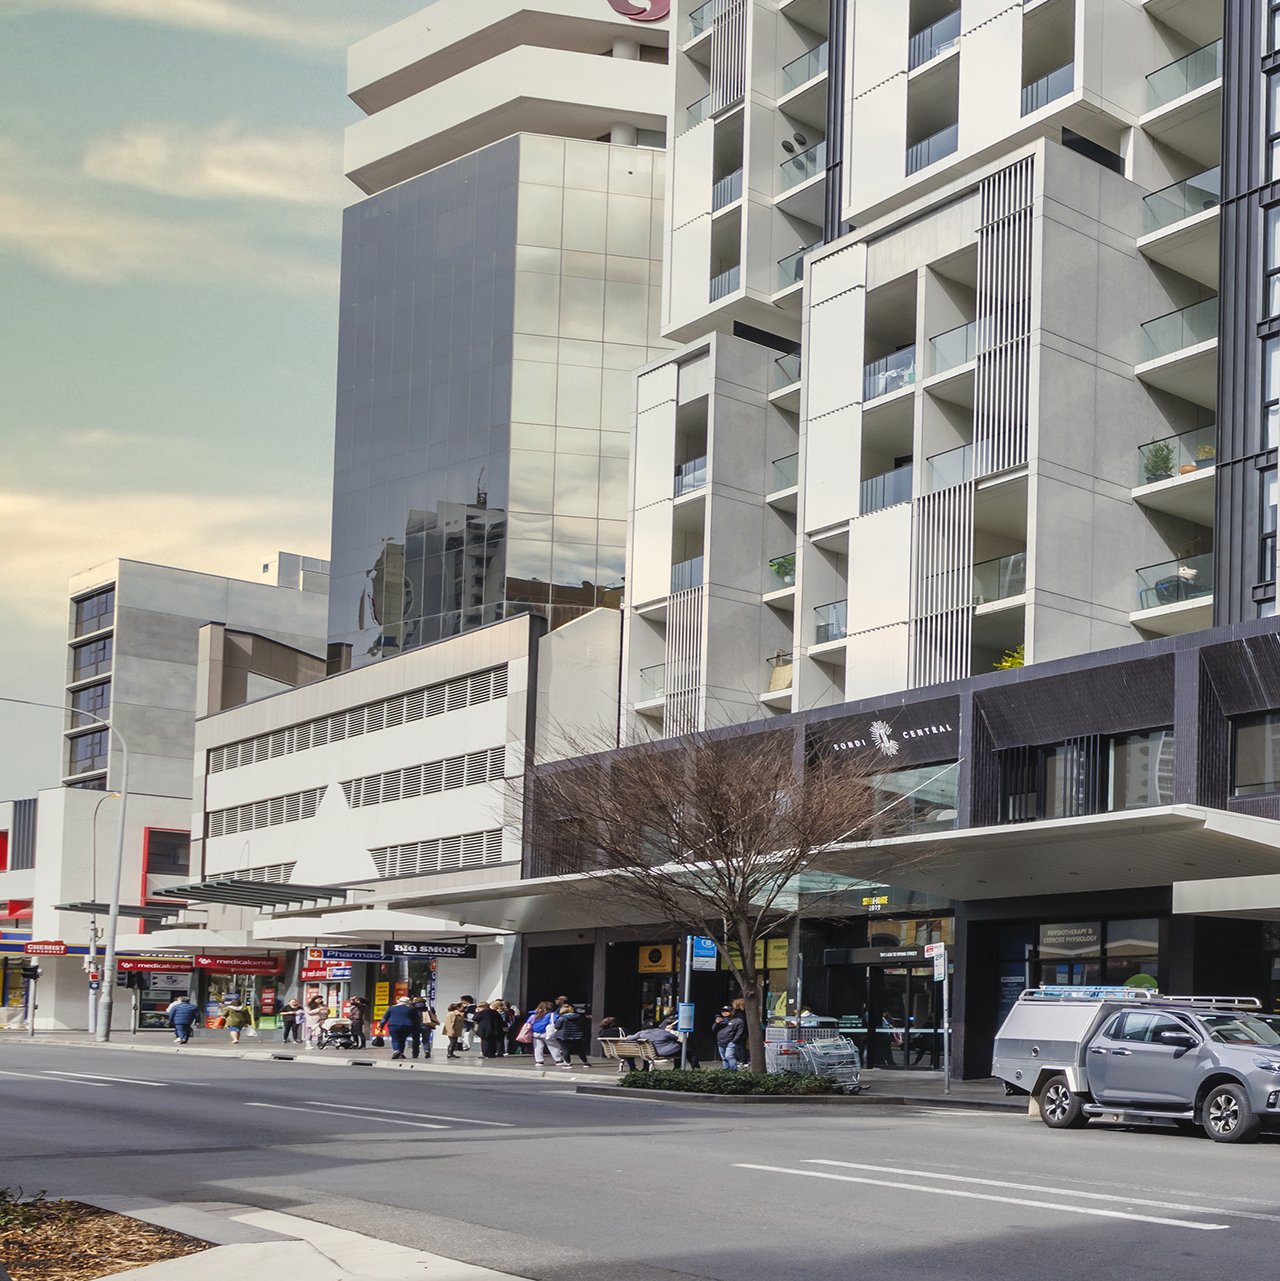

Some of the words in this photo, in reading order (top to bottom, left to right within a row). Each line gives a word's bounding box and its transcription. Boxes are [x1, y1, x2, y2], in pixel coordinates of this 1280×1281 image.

[902, 724, 953, 739] CENTRAL
[833, 739, 866, 751] BONDI
[1047, 928, 1088, 937] PHYSIOTHERAPY
[1065, 935, 1098, 943] PHYSIOLOGY
[394, 944, 417, 952] BIG
[419, 945, 466, 954] SMOKE
[326, 950, 386, 960] Pharmacy
